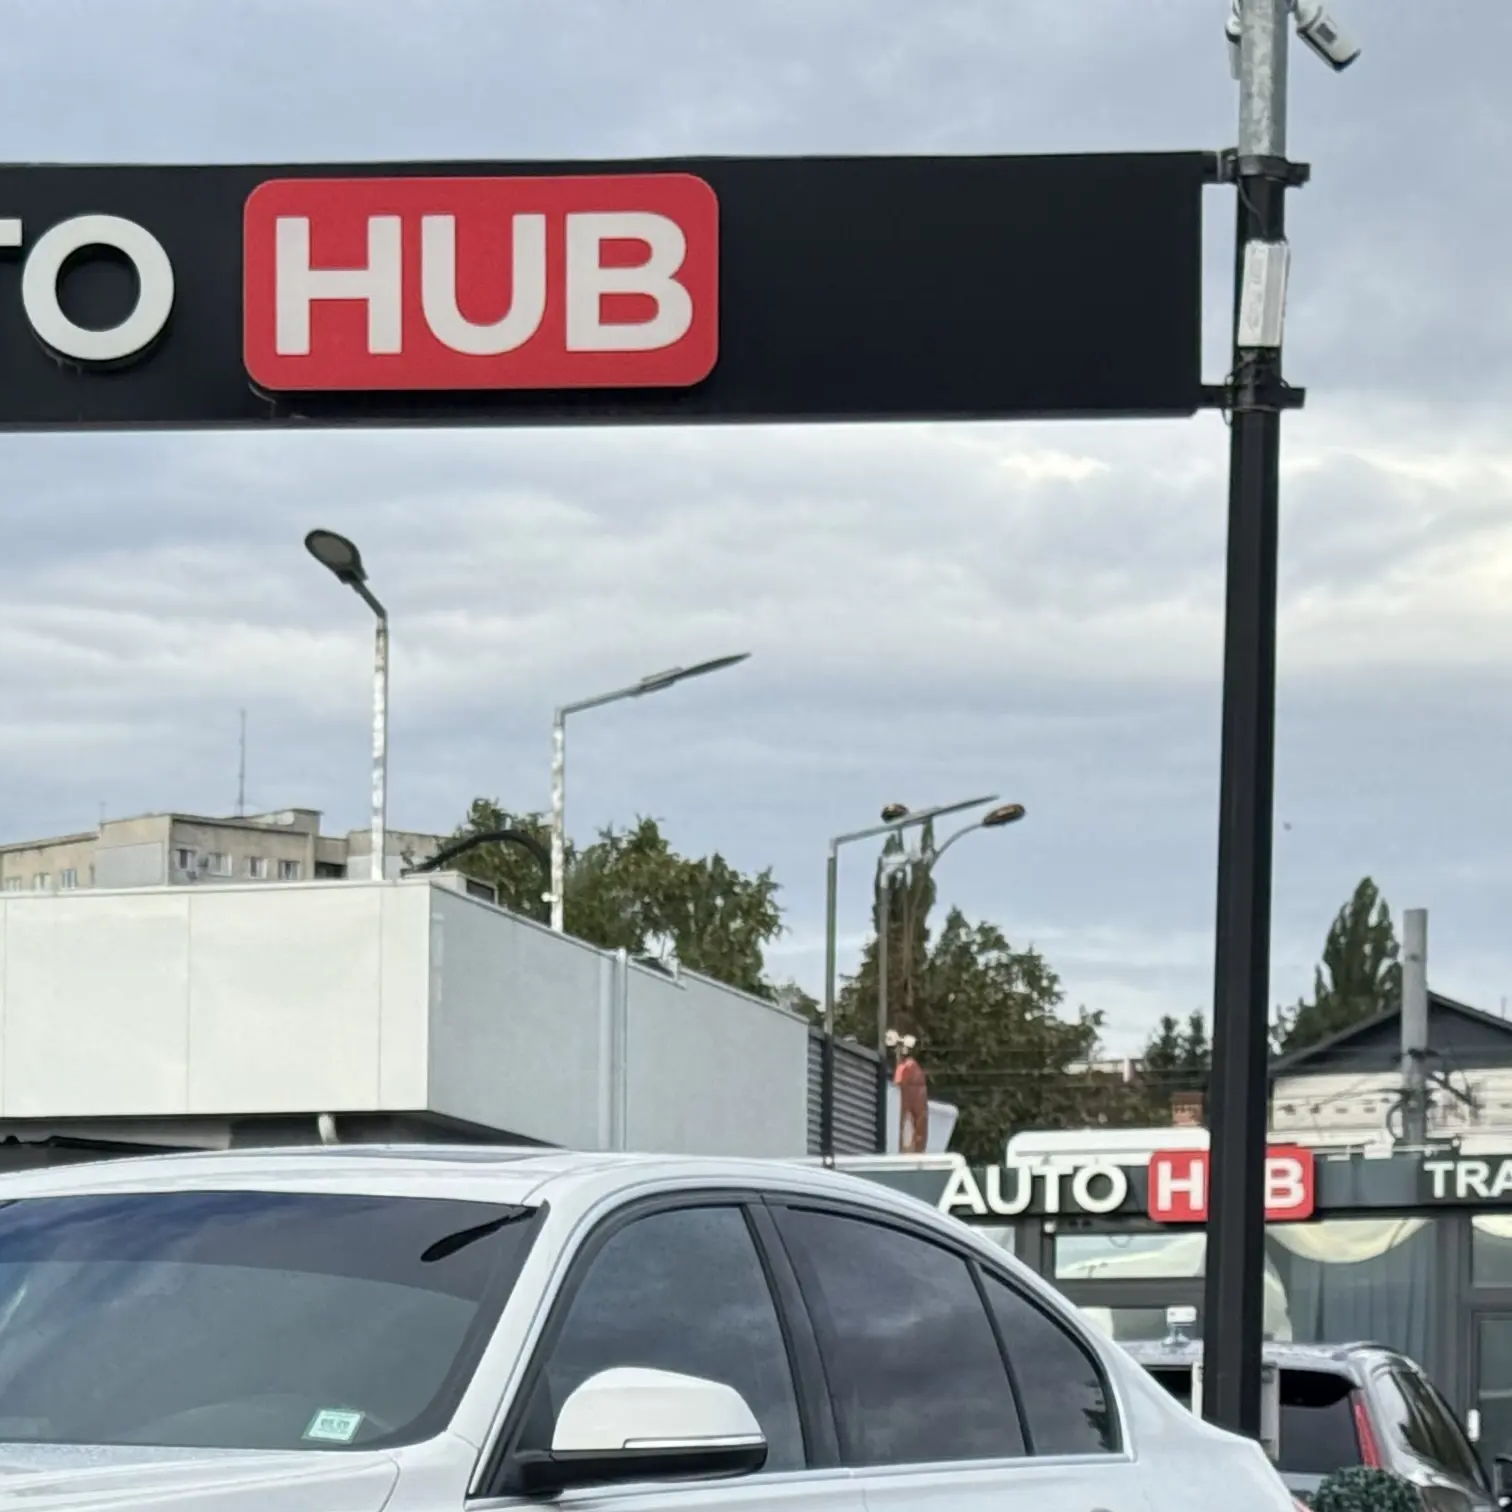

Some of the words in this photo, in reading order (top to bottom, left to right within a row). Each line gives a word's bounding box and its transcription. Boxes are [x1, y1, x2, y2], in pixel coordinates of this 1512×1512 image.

[275, 211, 693, 356] HUB
[938, 1163, 1128, 1215] AUTO
[1156, 1158, 1305, 1212] HB
